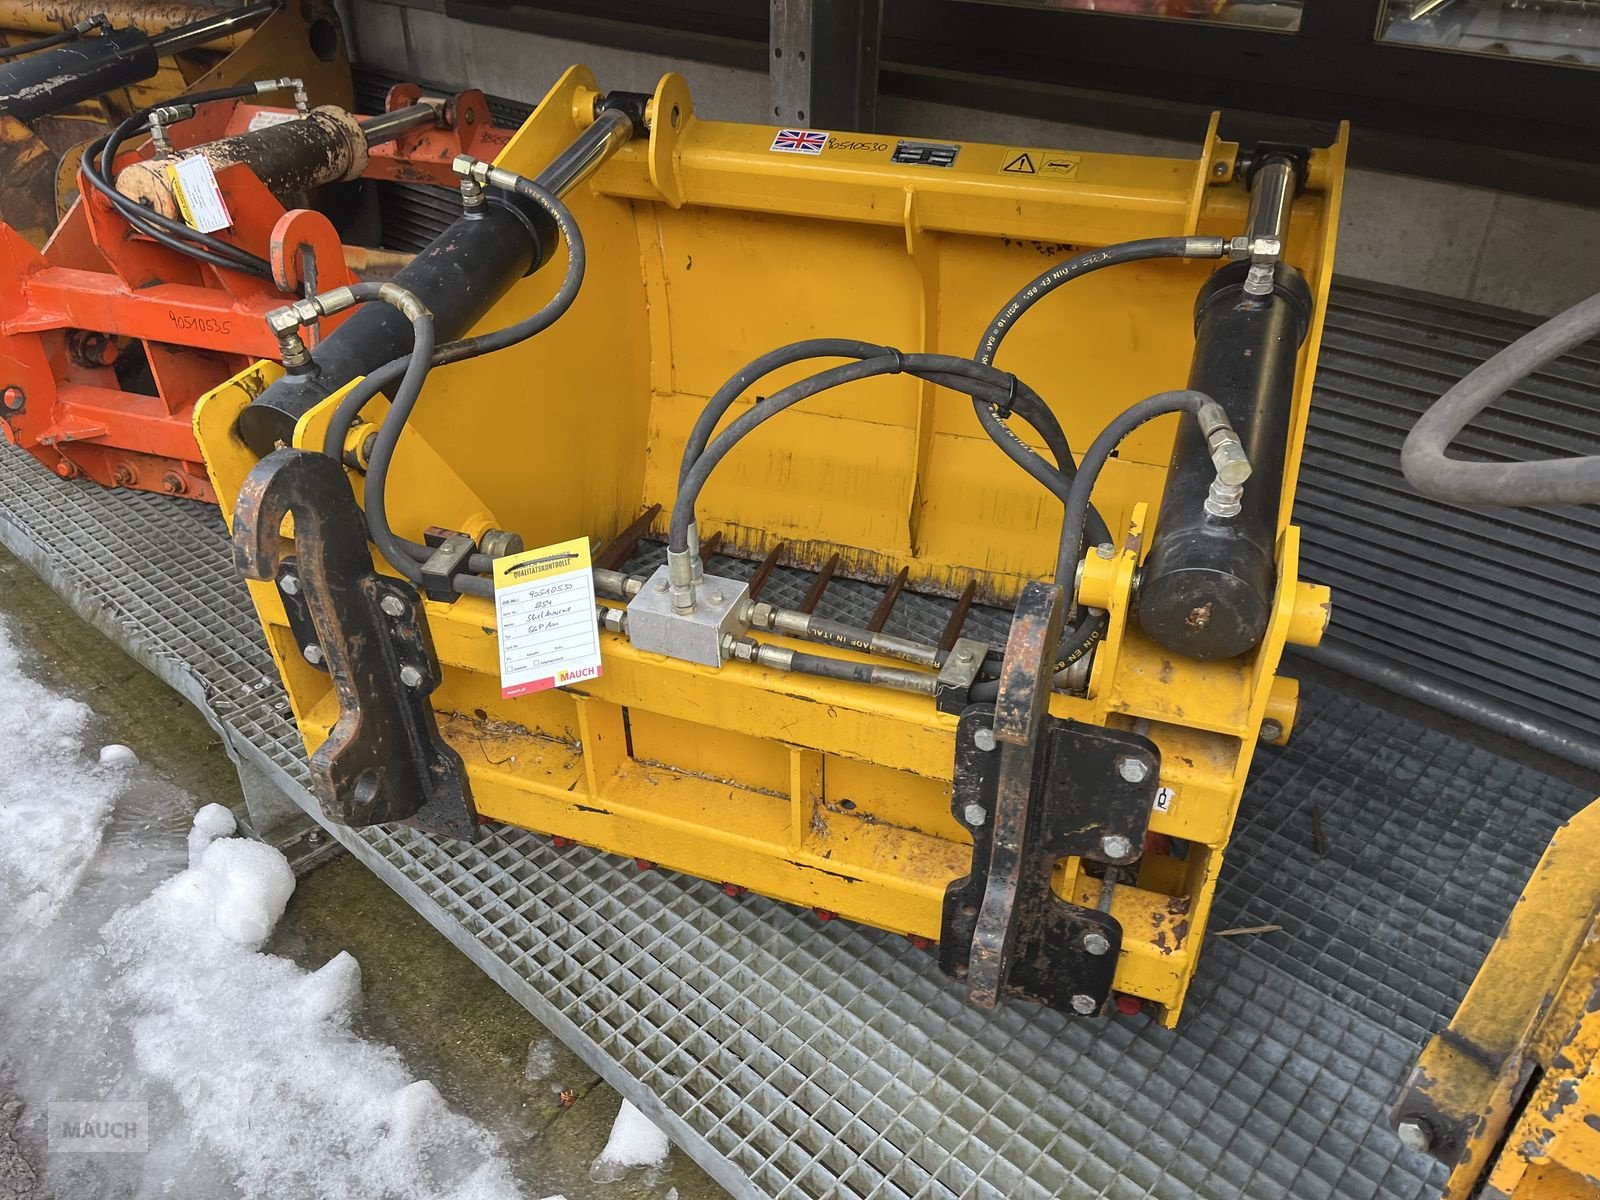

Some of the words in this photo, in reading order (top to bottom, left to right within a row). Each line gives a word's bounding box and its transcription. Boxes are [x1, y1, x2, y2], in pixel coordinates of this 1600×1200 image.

[828, 137, 888, 152] 90510530
[1053, 267, 1069, 280] DIN
[169, 310, 232, 334] 90510535
[997, 318, 1007, 328] 10
[836, 634, 847, 643] IN
[1068, 649, 1082, 661] EN
[560, 666, 595, 682] MAUCH
